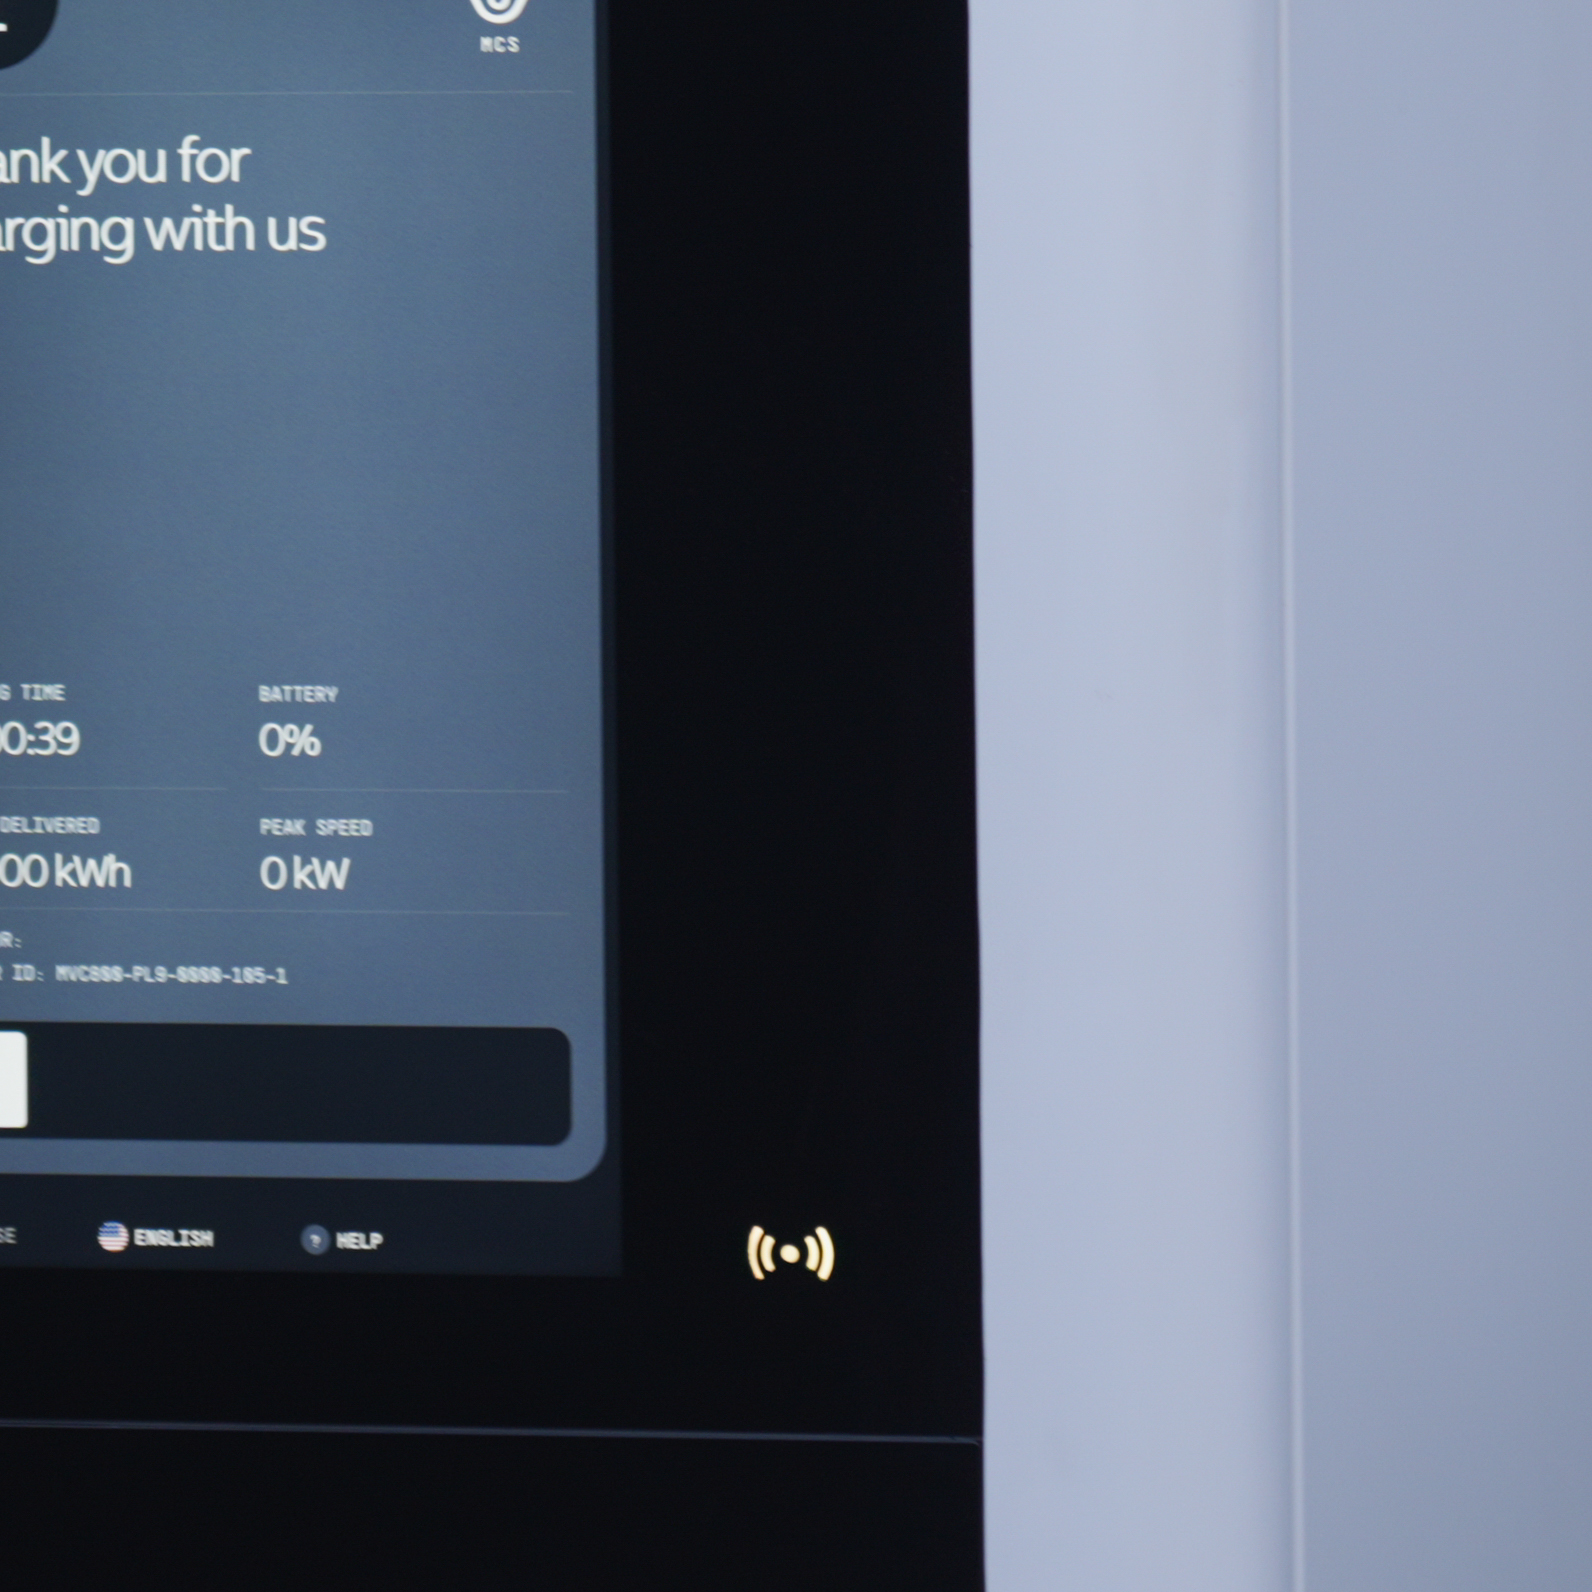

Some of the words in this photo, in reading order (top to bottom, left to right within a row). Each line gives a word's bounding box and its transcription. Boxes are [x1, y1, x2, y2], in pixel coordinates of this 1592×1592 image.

[479, 35, 520, 53] MCS
[75, 147, 167, 197] you
[176, 134, 252, 183] for
[143, 203, 256, 252] with
[267, 215, 327, 252] us
[19, 682, 66, 701] TIME
[258, 684, 339, 703] BATTERY
[258, 721, 322, 757] 0%
[259, 817, 306, 836] PEAK
[315, 817, 374, 837] SPEED
[54, 852, 132, 888] kWh
[259, 854, 288, 890] 0
[293, 854, 351, 890] kW
[11, 962, 44, 982] ID:
[133, 1227, 214, 1247] ENGLISH
[335, 1230, 384, 1250] HELP
